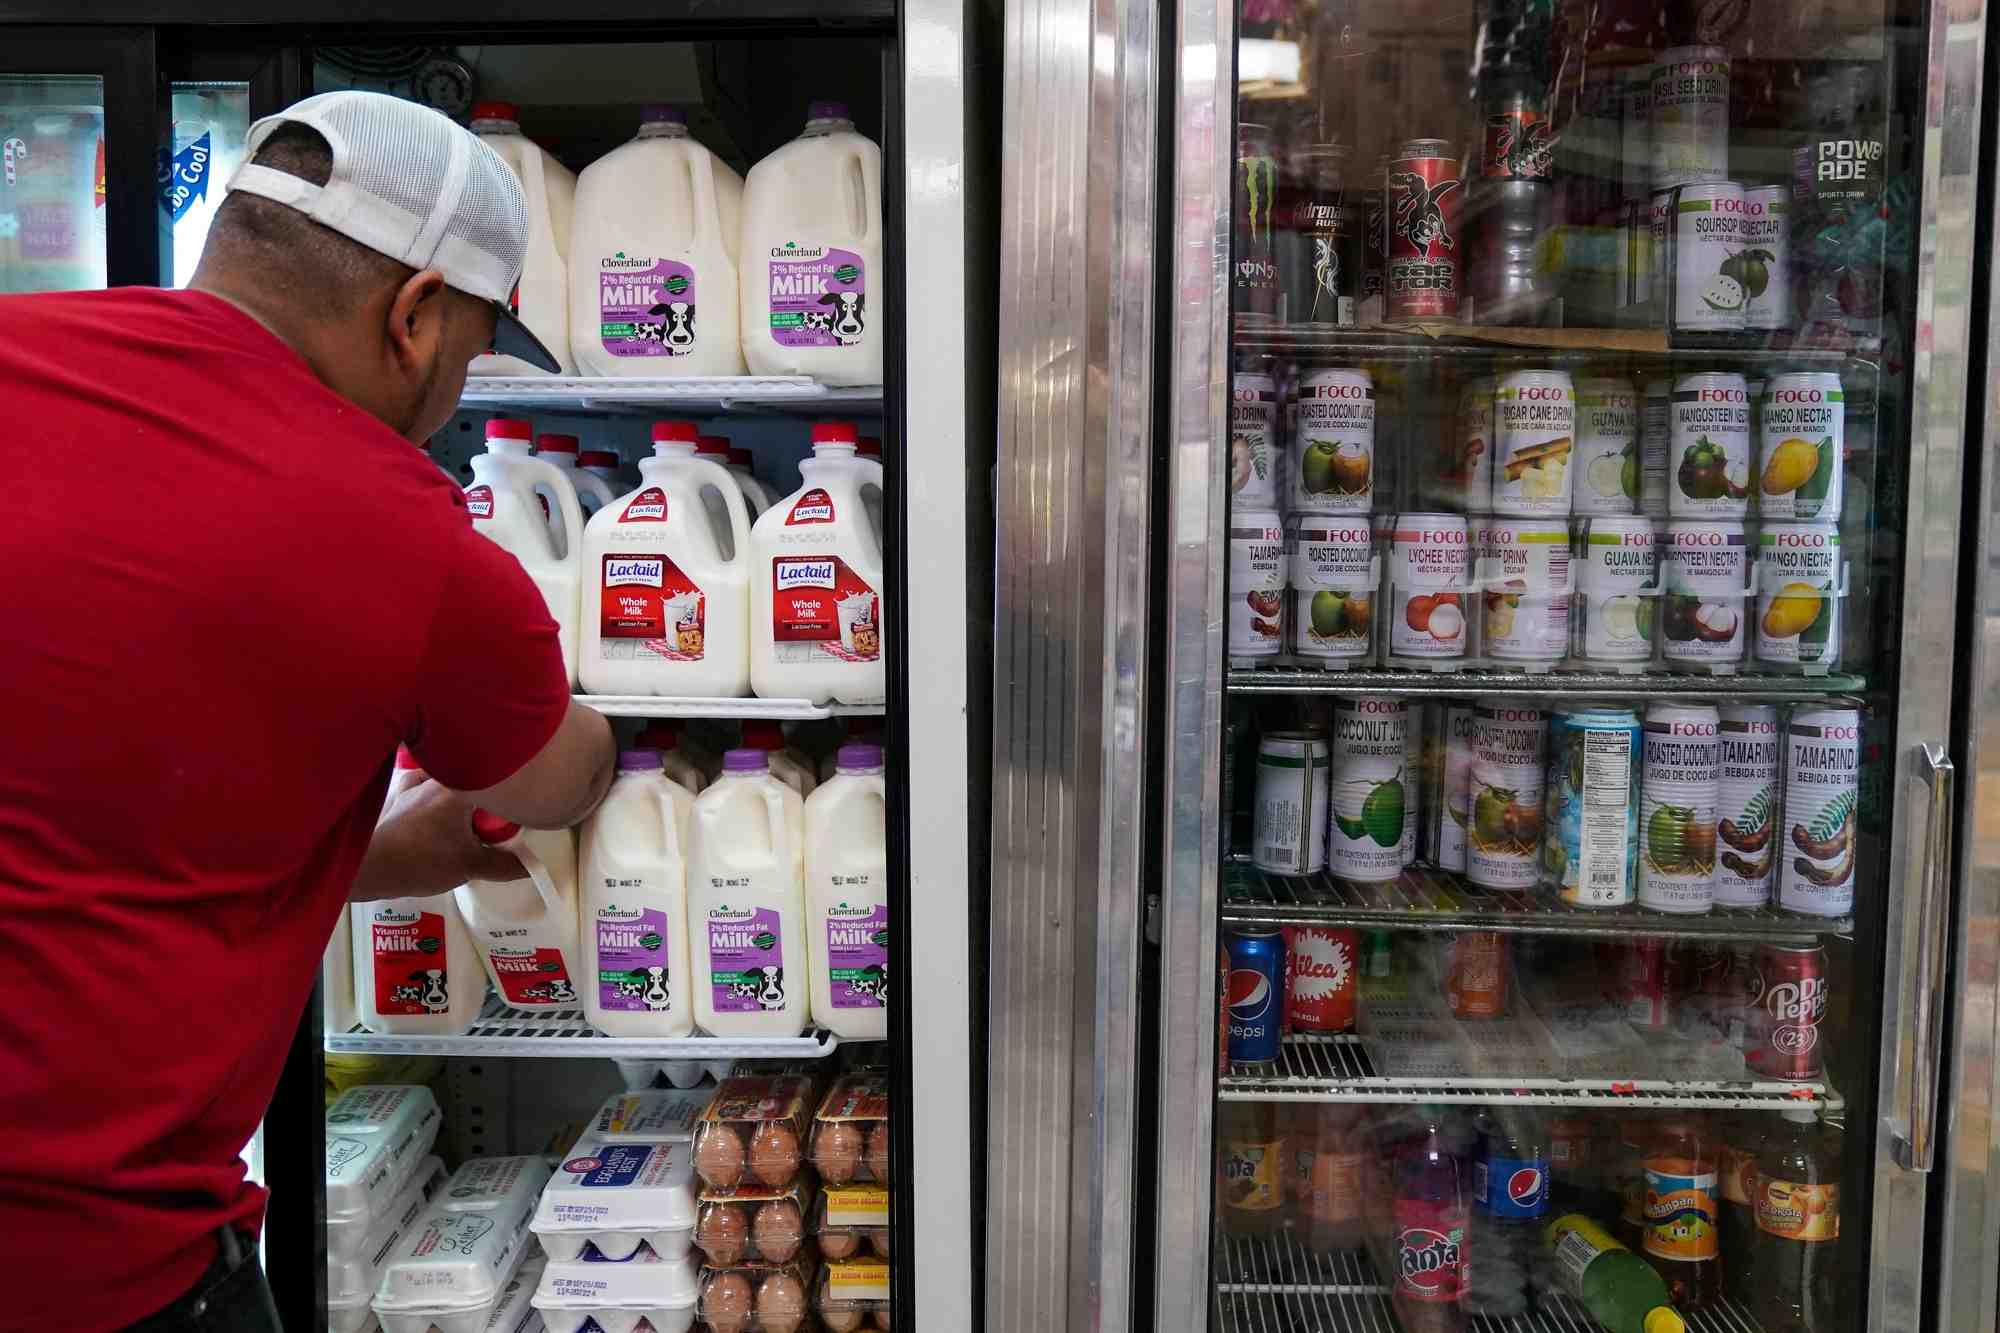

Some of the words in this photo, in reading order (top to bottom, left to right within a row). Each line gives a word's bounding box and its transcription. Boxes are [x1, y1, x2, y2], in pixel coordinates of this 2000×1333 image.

[1818, 139, 1883, 161] POWE
[181, 144, 209, 184] Cool
[1818, 160, 1867, 181] ADE
[1696, 218, 1738, 233] SOURSOP
[771, 248, 822, 257] Cloverland
[602, 258, 651, 268] Cloverland
[773, 265, 787, 274] 2%
[789, 265, 822, 273] Reduced
[602, 275, 618, 285] 2%
[619, 275, 652, 284] Reduced
[772, 274, 829, 295] Milk
[602, 284, 659, 305] Milk
[1318, 386, 1361, 399] FOCO
[1519, 387, 1562, 400] FOCO
[1702, 389, 1744, 402] FOCO
[1776, 390, 1822, 402] FOCO
[1241, 408, 1266, 420] DRINK
[1328, 404, 1360, 418] COCONUT
[1529, 406, 1552, 420] CANE
[1680, 407, 1734, 422] MANGOSTEEN
[1797, 408, 1832, 423] NECTAR
[1592, 412, 1624, 426] GUAVA
[631, 505, 662, 514] Lactaid
[796, 505, 829, 516] Lactaid
[1329, 530, 1368, 543] FOCO
[1423, 531, 1464, 544] FOCO
[1676, 532, 1722, 546] FOCO
[1778, 533, 1824, 546] FOCO
[1308, 548, 1338, 563] ROASTED
[1408, 548, 1440, 563] LYCHEE
[1503, 549, 1528, 564] DRINK
[1604, 551, 1641, 566] GUAVA
[1709, 551, 1738, 567] NECTAR
[1800, 552, 1834, 567] NECTAR
[609, 562, 660, 577] Lactaid
[780, 565, 831, 579] Lactaid
[619, 598, 648, 607] Whole
[792, 600, 821, 609] Whole
[624, 606, 642, 616] Milk
[797, 609, 817, 618] Milk
[1494, 709, 1537, 721] FOCO
[1337, 719, 1387, 741] COCONUT
[1674, 722, 1716, 736] FOCO
[1371, 746, 1383, 754] DE
[1648, 747, 1681, 765] ROASTED
[1796, 746, 1852, 771] TAMARIND
[1726, 766, 1754, 778] BEBIDA
[1757, 767, 1768, 778] DE
[1799, 773, 1829, 784] BEBIDA
[1831, 774, 1843, 785] DE
[375, 927, 409, 935] Vitamin
[723, 924, 756, 932] Reduced
[376, 936, 420, 952] Milk
[600, 931, 641, 948] Milk
[712, 933, 754, 948] Milk
[830, 930, 873, 945] Milk
[494, 962, 539, 972] Milk
[617, 1156, 642, 1173] BEST
